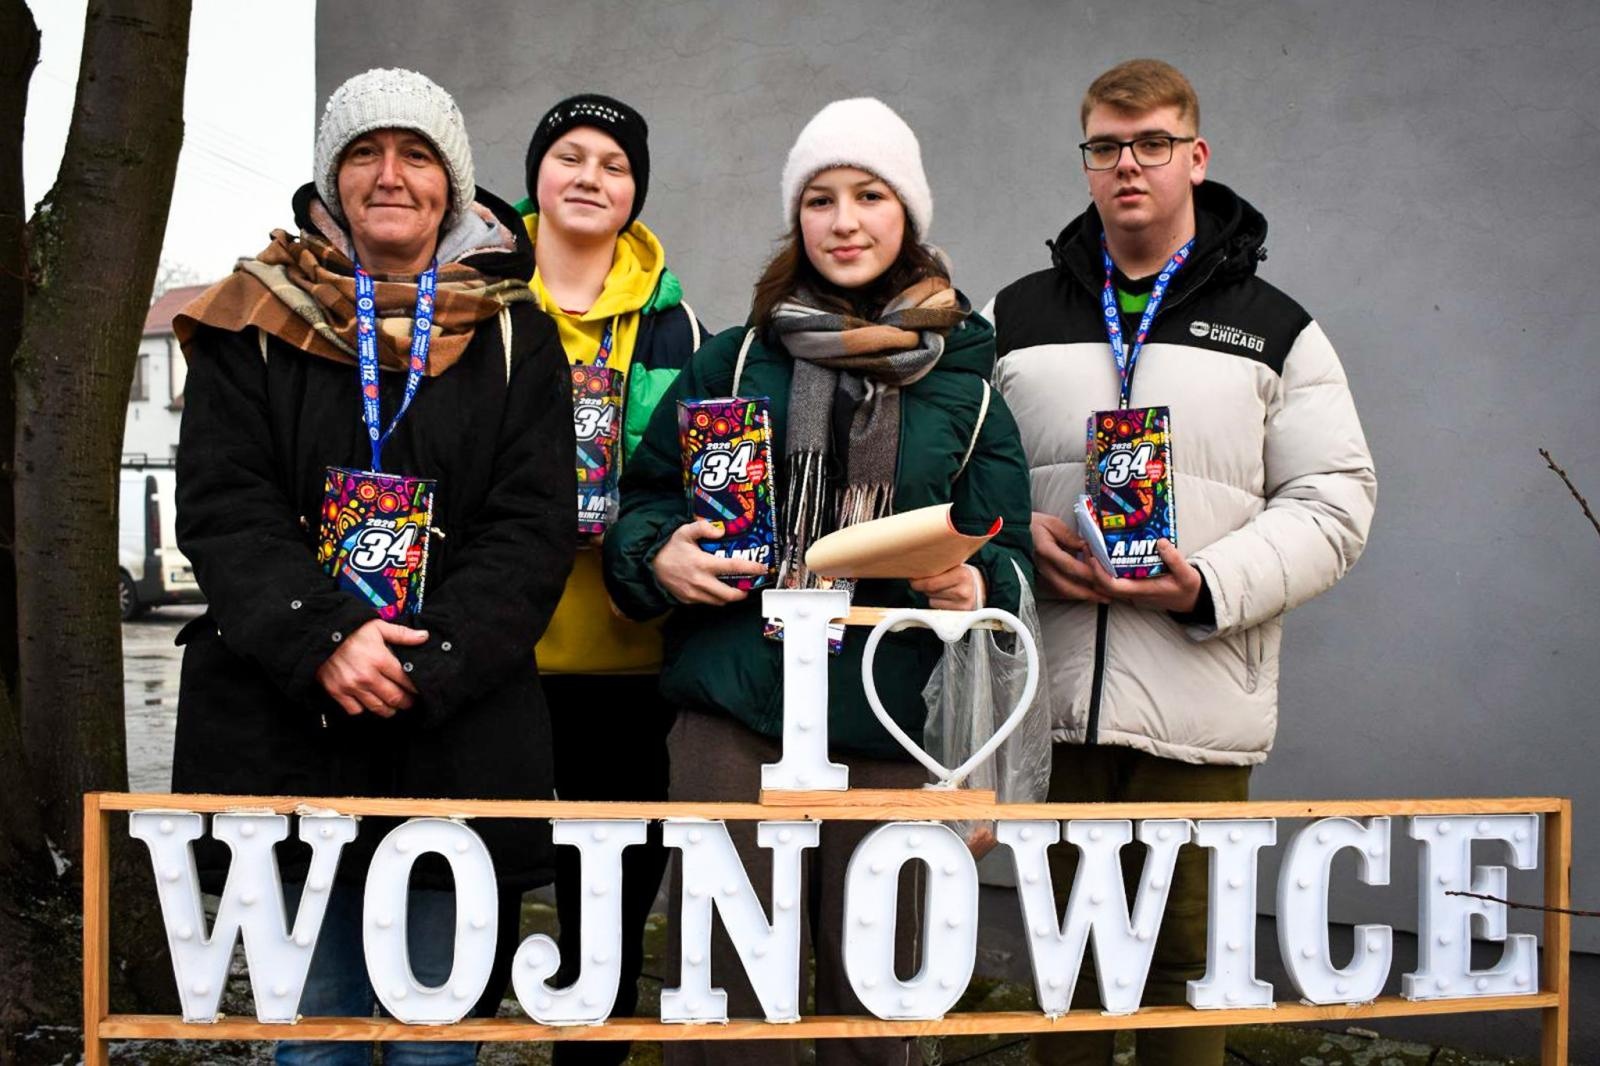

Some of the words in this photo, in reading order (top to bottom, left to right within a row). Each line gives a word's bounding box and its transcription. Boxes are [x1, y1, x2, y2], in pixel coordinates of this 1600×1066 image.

[1210, 329, 1266, 353] CHICAGO
[363, 364, 376, 381] 112
[576, 406, 614, 440] 34
[706, 442, 731, 450] 2026
[702, 442, 752, 489] 34
[1105, 443, 1153, 486] 34
[365, 518, 396, 529] 2026
[352, 525, 416, 570] 34
[1112, 541, 1126, 556] A
[761, 588, 850, 791] I
[128, 811, 1539, 1026] WOJNOWICE
